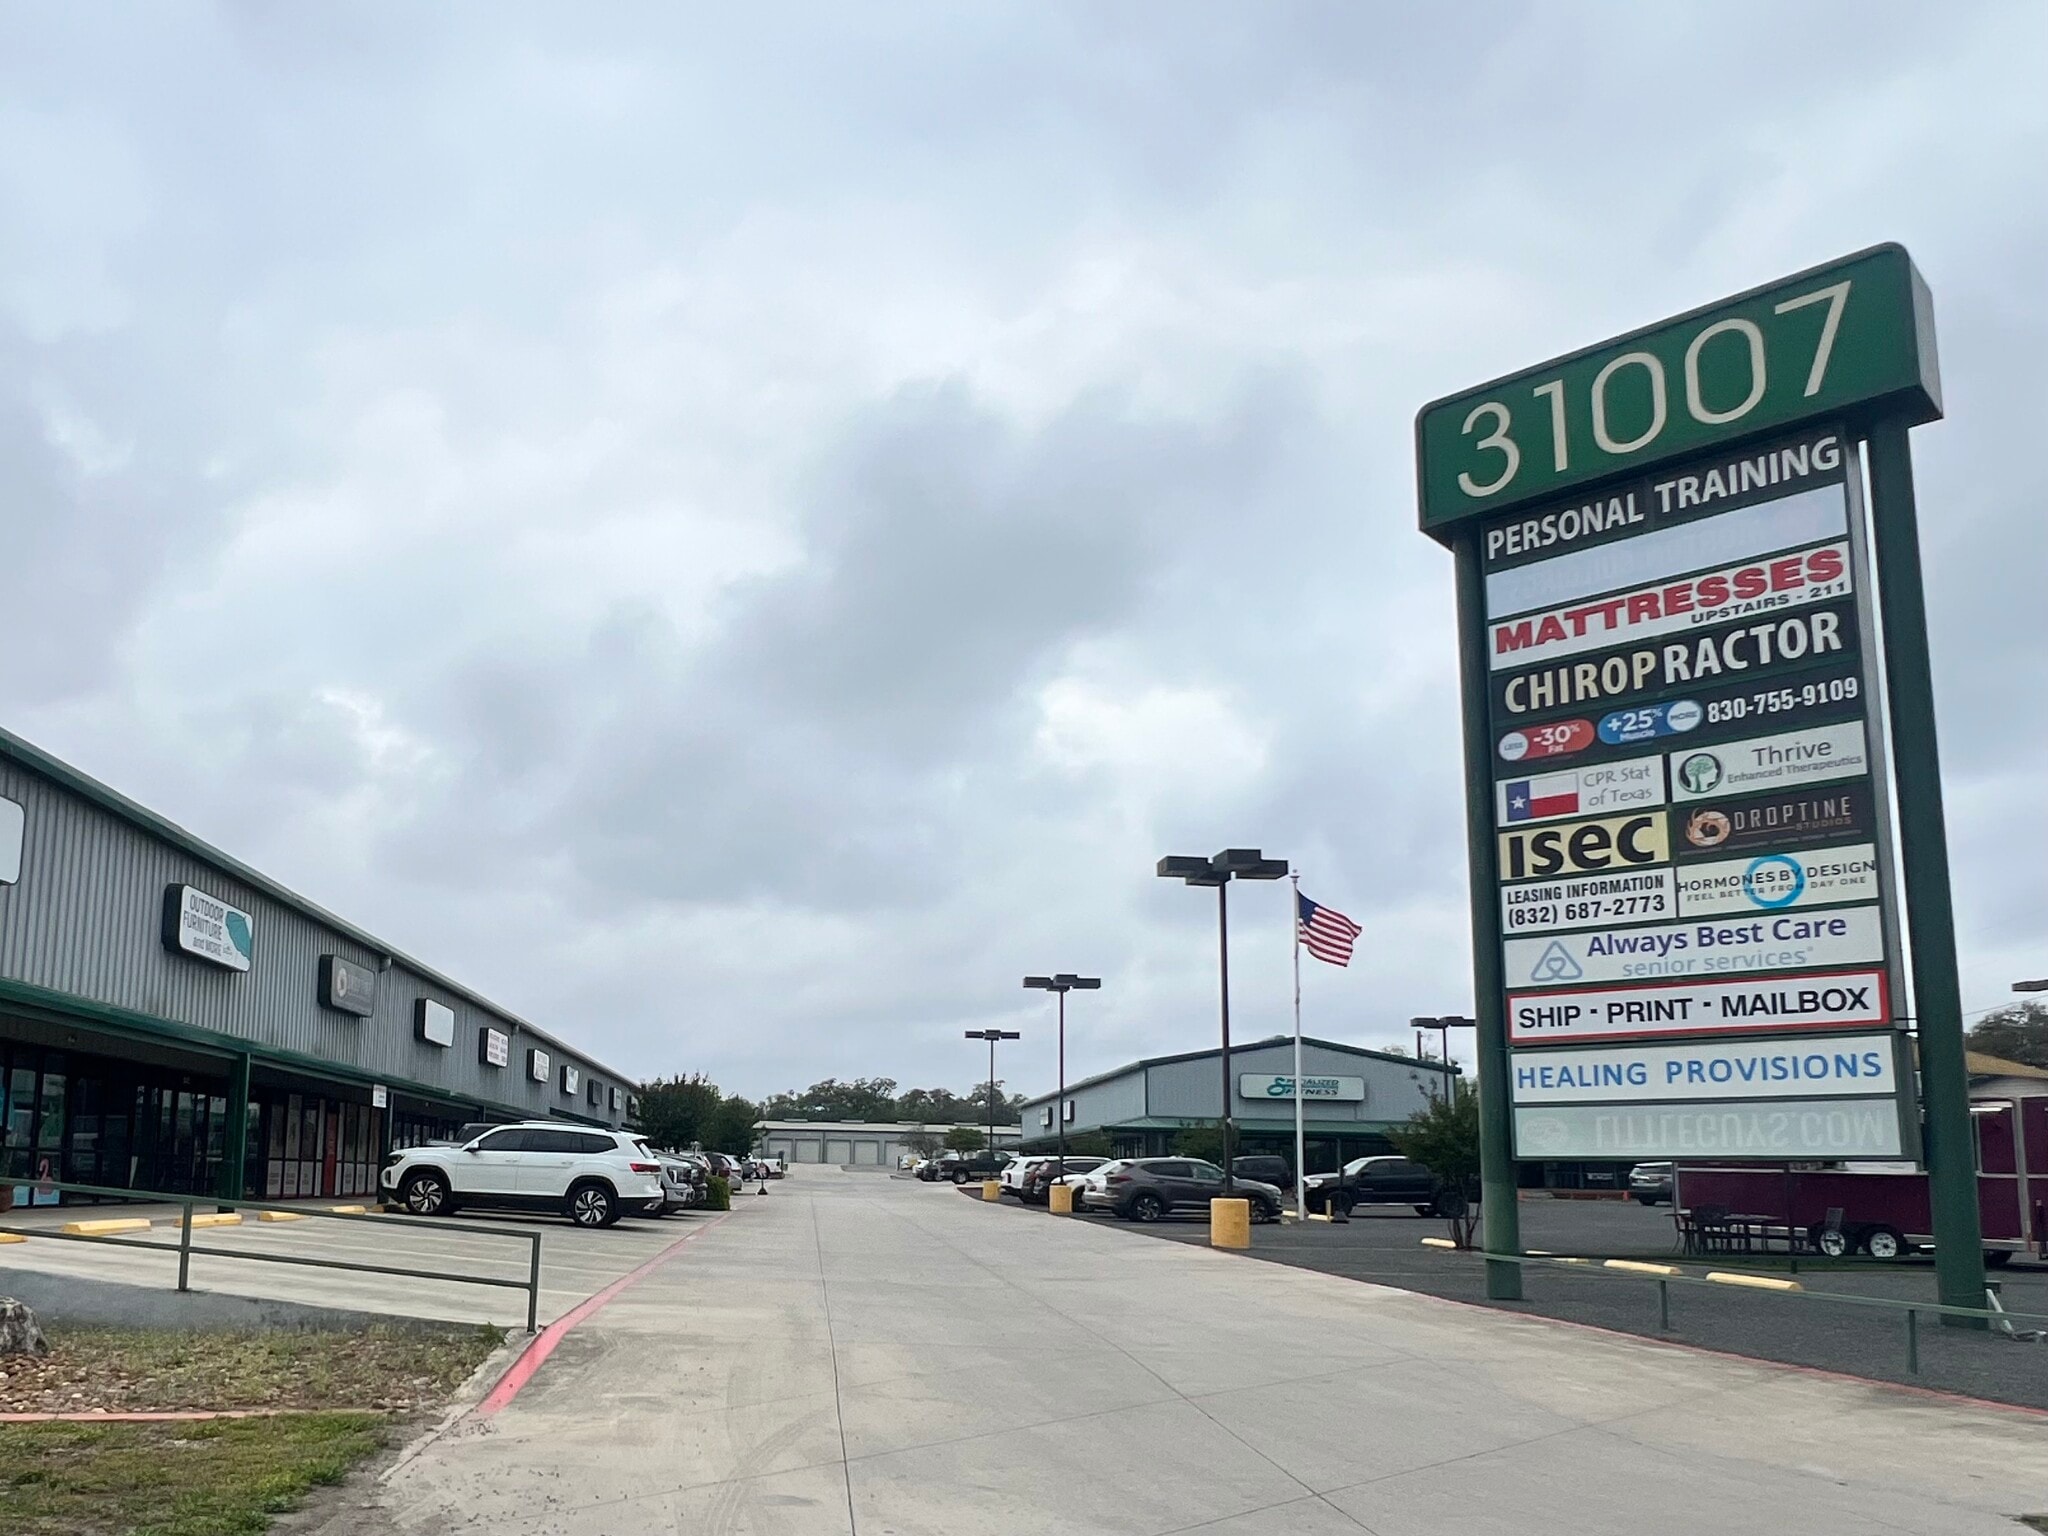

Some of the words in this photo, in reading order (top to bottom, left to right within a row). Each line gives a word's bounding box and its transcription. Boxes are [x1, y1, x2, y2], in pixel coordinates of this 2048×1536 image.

[1457, 280, 1852, 498] 31007
[1488, 493, 1645, 561] PERSONAL
[1654, 436, 1841, 514] TRAINING
[1495, 549, 1844, 655] MATTRESSES
[1691, 594, 1790, 624] UPSTAIRS
[1809, 581, 1846, 599] 211
[1504, 610, 1842, 714] CHIROPRACTOR
[1707, 676, 1859, 724] 830-755-9109
[1727, 767, 1783, 784] Enhanced
[1786, 754, 1863, 775] Therapeutics
[1751, 741, 1833, 766] Thrive
[1584, 770, 1617, 787] CPR
[1621, 765, 1651, 783] Stat
[1588, 787, 1607, 806] of
[1611, 787, 1653, 802] Texas
[1733, 796, 1852, 830] DROPTINE
[1507, 886, 1562, 905] LEASING
[1566, 874, 1664, 899] INFORMATION
[1676, 871, 1775, 893] HORMONES
[1779, 867, 1802, 881] BY
[1806, 860, 1877, 879] DESIGN
[1686, 893, 1715, 902] FEEL
[1810, 880, 1834, 889] DAY
[1840, 876, 1867, 886] ONE
[184, 910, 222, 941] FURNITURE
[190, 894, 224, 924] OUTDOOR
[1508, 904, 1559, 929] (832)
[1565, 894, 1666, 920] 687-2773
[1587, 931, 1689, 958] Always
[1696, 921, 1764, 948] Best
[1772, 918, 1847, 941] Care
[1622, 957, 1697, 978] senior
[1518, 1004, 1580, 1029] SHIP
[1607, 997, 1693, 1024] PRINT
[1721, 986, 1870, 1018] MAILBOX
[1518, 1061, 1647, 1089] HEALING
[1666, 1051, 1882, 1085] PROVISIONS
